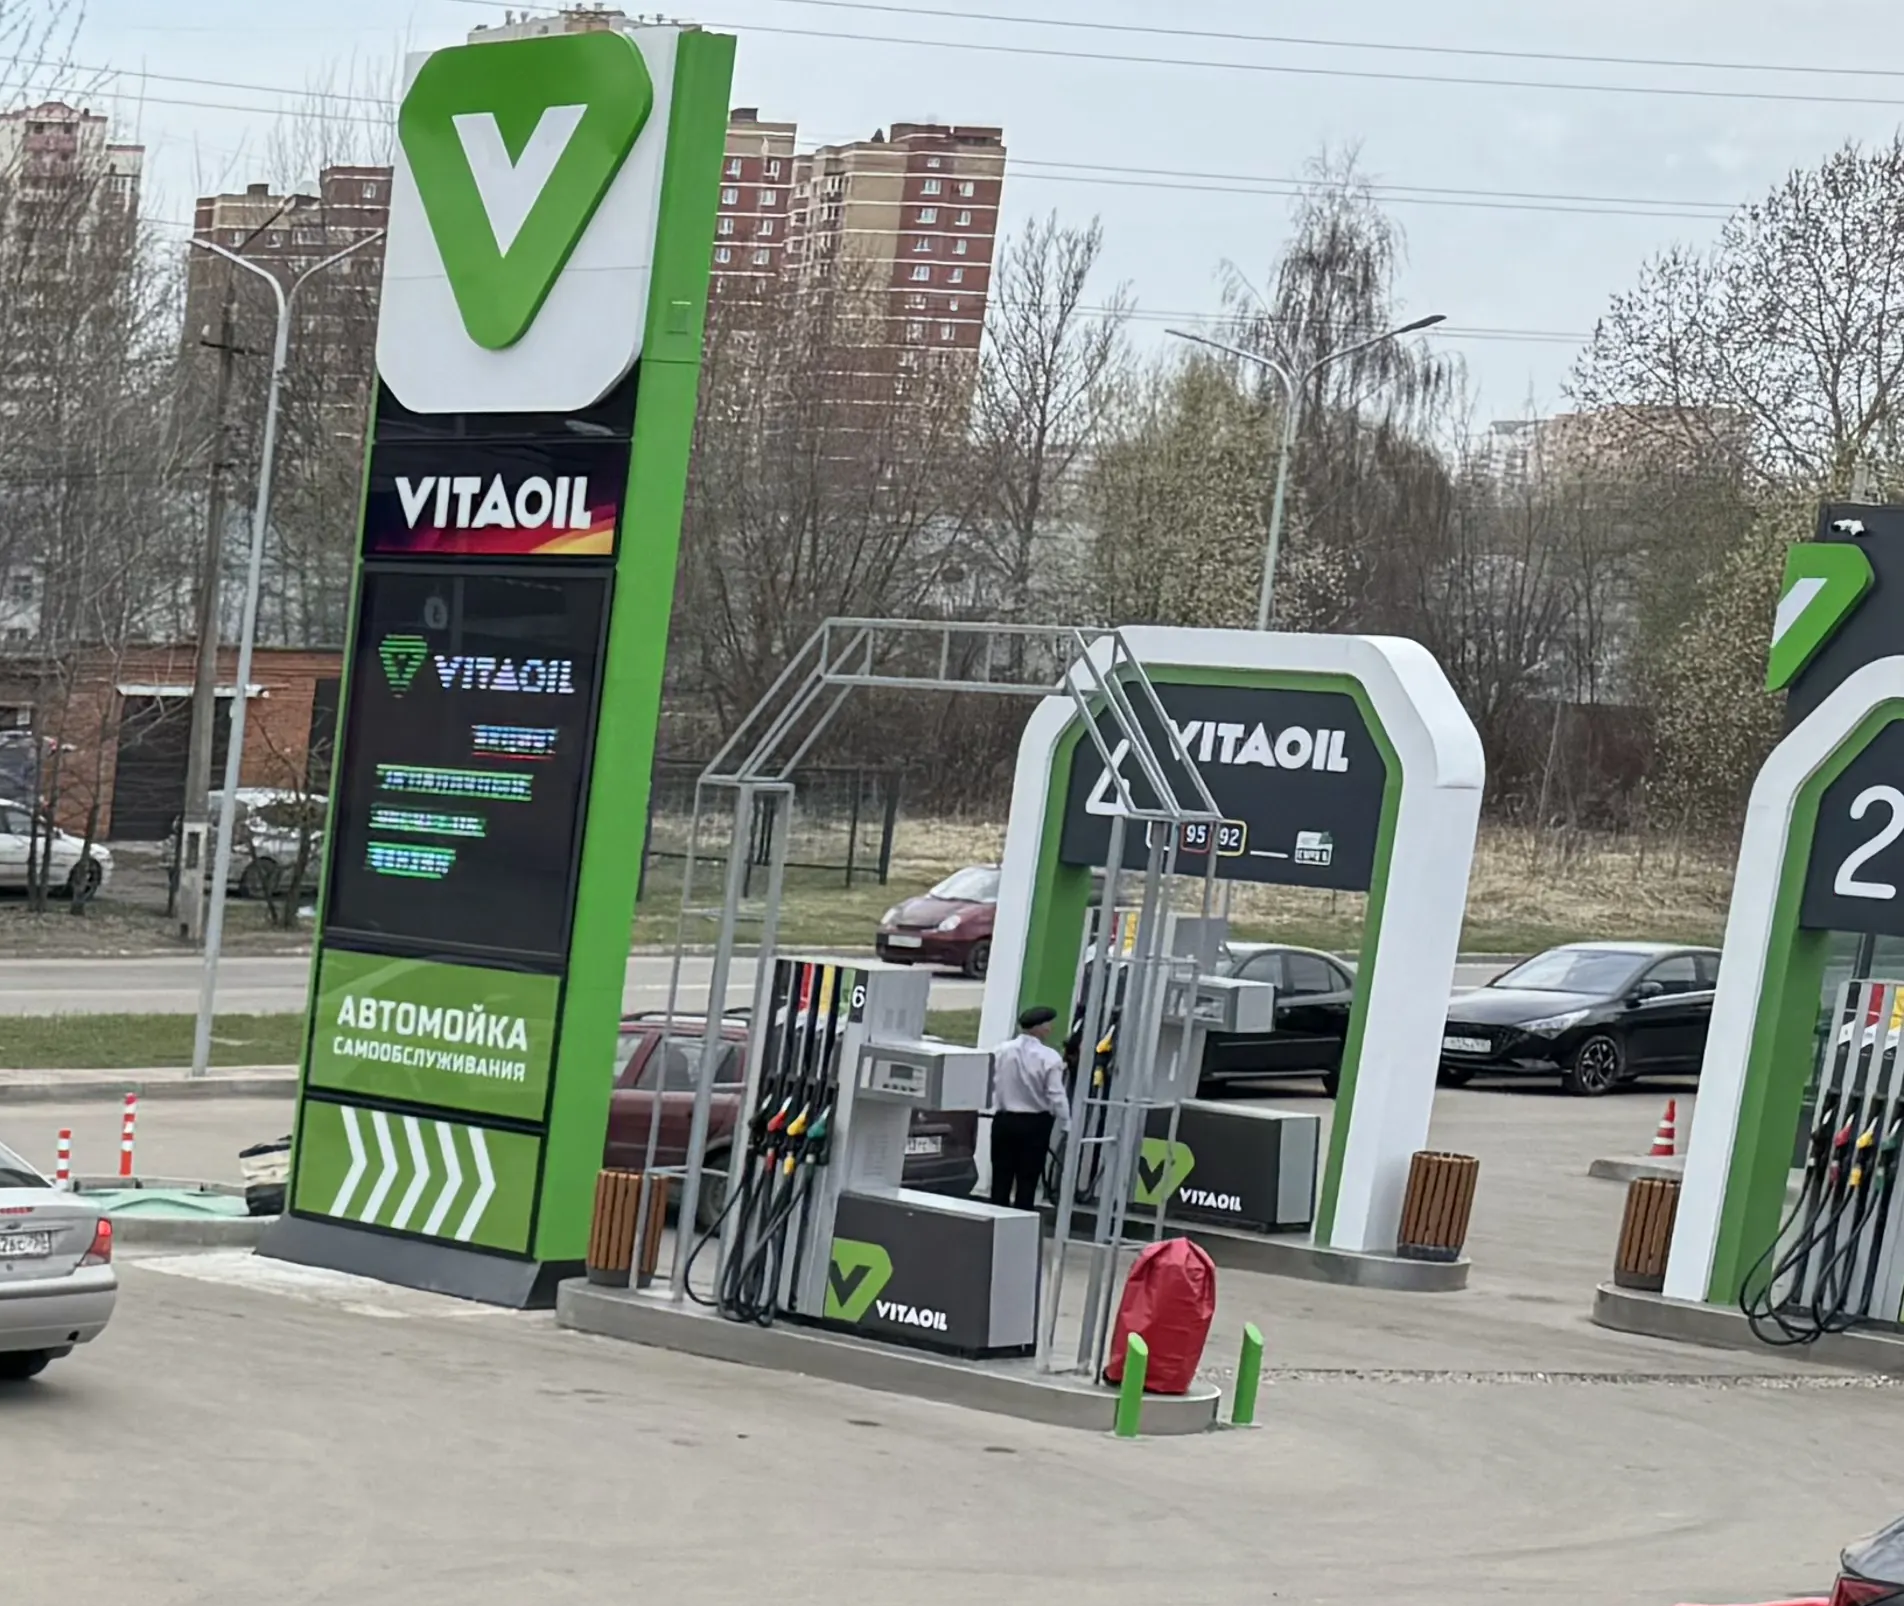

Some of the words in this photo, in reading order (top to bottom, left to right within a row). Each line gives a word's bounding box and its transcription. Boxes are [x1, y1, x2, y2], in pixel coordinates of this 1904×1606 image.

[394, 475, 592, 530] VITAOIL
[433, 655, 576, 694] VITAOIL
[1168, 719, 1349, 773] VITAOIL
[1085, 738, 1132, 816] 4
[1185, 824, 1206, 844] 95
[1219, 827, 1240, 847] 92
[1834, 784, 1904, 900] 2
[852, 985, 866, 1008] 6
[336, 995, 528, 1052] АВТОМОЙКА
[332, 1035, 527, 1083] САМООБСЛУЖИВАНИЯ
[1179, 1187, 1242, 1212] VITAOIL
[876, 1299, 948, 1331] VITAOIL
